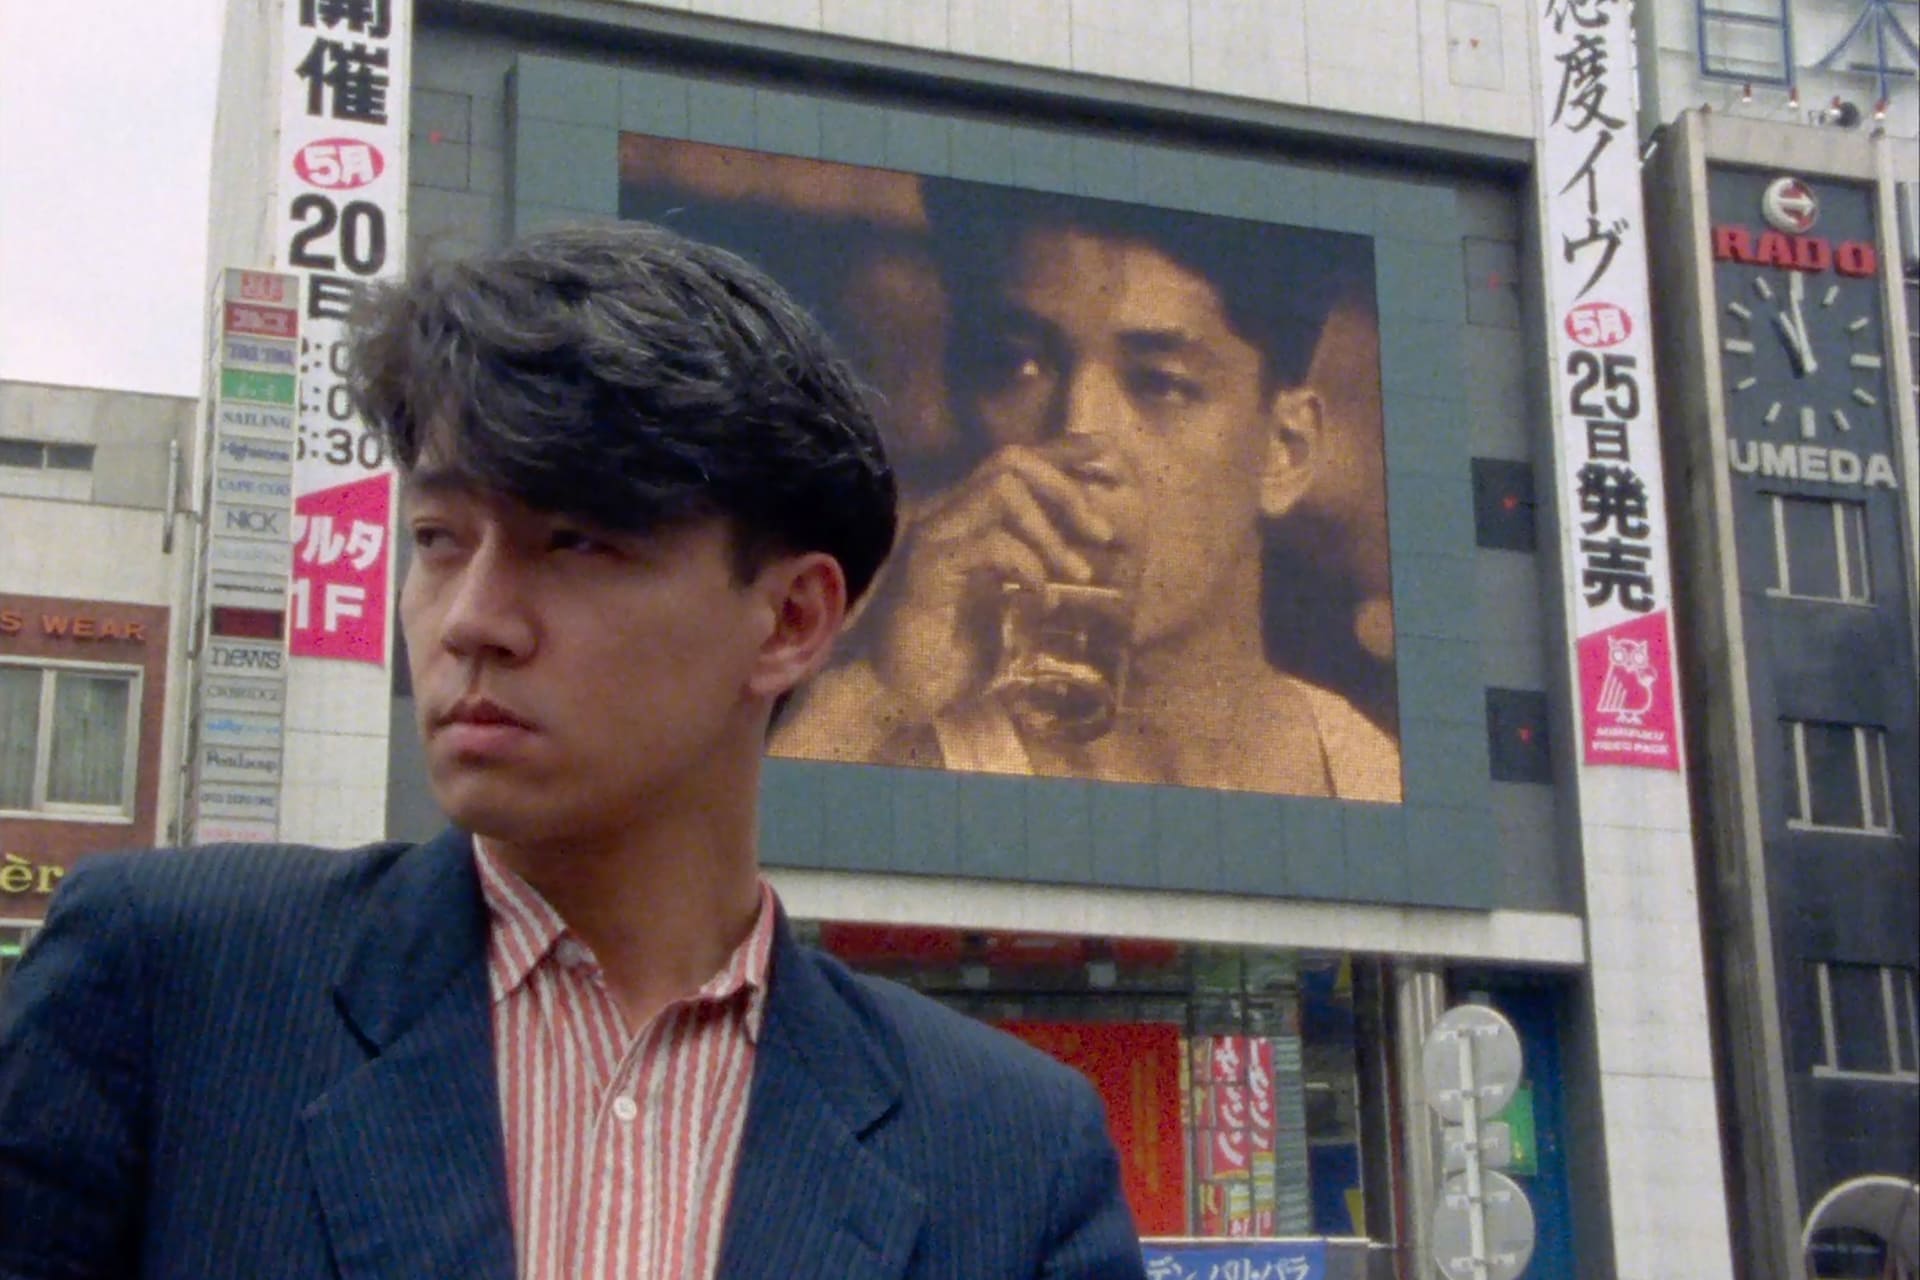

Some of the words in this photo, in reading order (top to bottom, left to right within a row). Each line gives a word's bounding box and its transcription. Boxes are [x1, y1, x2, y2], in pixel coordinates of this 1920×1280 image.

[303, 145, 376, 187] 5月
[1711, 224, 1878, 277] RADO
[296, 424, 384, 470] :30
[1727, 437, 1898, 489] UMEDA
[226, 510, 278, 535] NICK
[42, 614, 147, 640] WEAR
[291, 577, 367, 633] 1F
[210, 646, 282, 671] news
